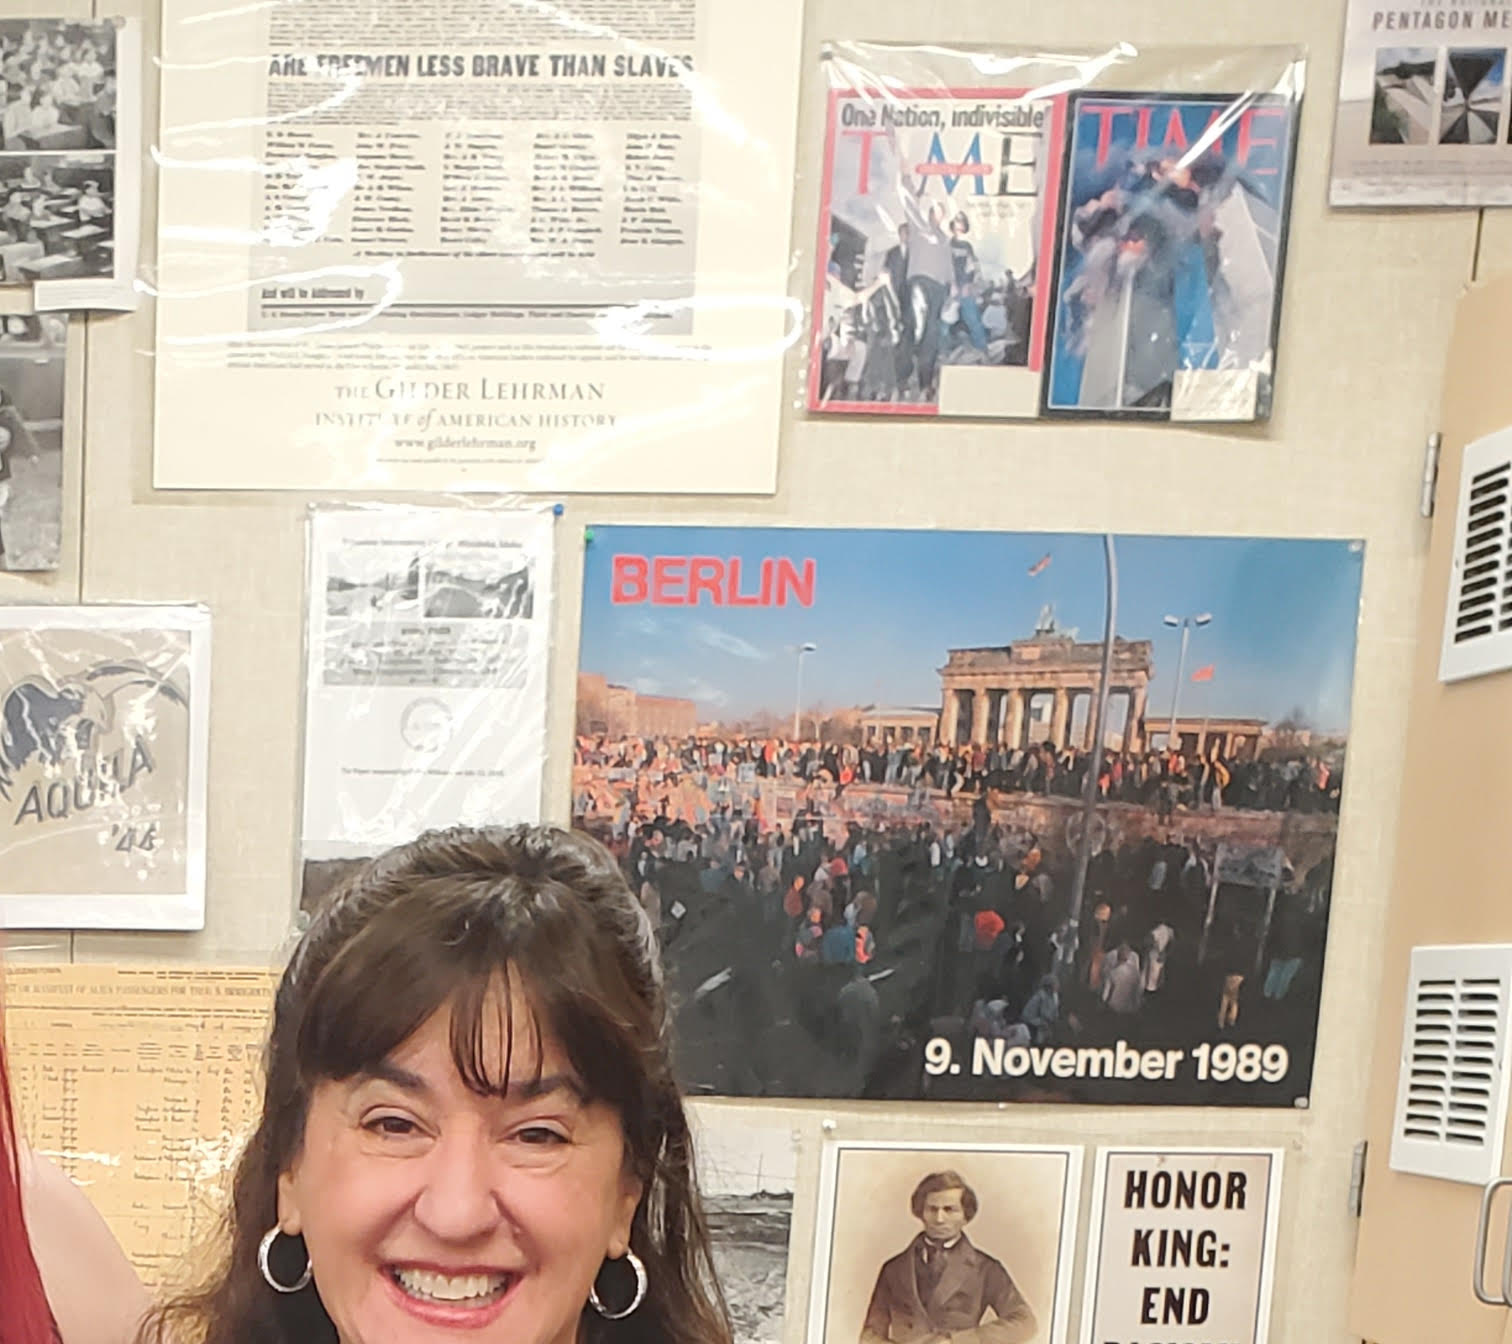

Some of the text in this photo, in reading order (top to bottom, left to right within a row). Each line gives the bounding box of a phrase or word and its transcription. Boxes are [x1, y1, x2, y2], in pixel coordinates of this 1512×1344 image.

[1372, 10, 1472, 31] PENTAGON
[417, 53, 465, 77] LESS
[472, 53, 541, 77] BRAVE
[549, 53, 607, 77] THAN
[841, 103, 877, 127] One
[1080, 105, 1285, 175] TIME
[841, 130, 1043, 197] TME
[481, 377, 606, 400] LEHRMAN
[417, 407, 437, 433] of
[438, 413, 533, 427] AMERICAN
[538, 413, 617, 428] HISTORY
[610, 554, 817, 608] BERLIN
[923, 1037, 1289, 1083] 9. November 1989
[1124, 1170, 1247, 1211] HONOR
[1130, 1229, 1230, 1269] KING:
[1140, 1286, 1210, 1326] END
